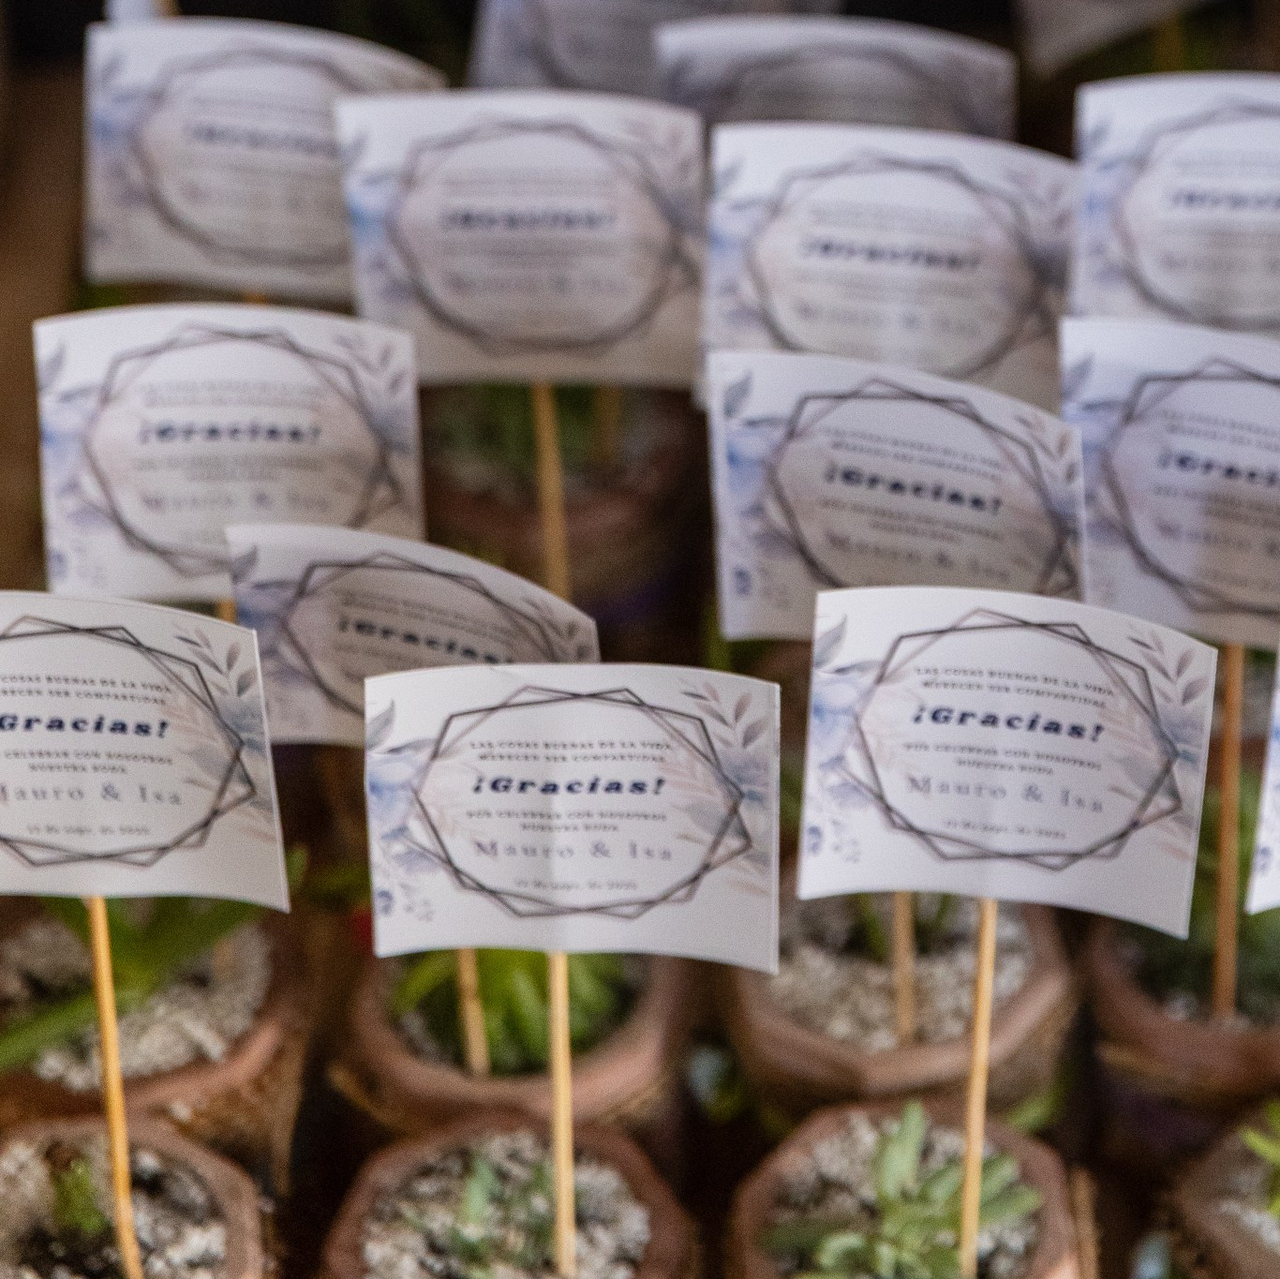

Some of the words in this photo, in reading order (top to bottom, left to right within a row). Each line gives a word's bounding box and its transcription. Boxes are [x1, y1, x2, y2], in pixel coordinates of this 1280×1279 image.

[0, 714, 168, 738] Gracias!
[913, 703, 1104, 743] ¡Gracias!
[473, 775, 665, 795] ¡Gracias!
